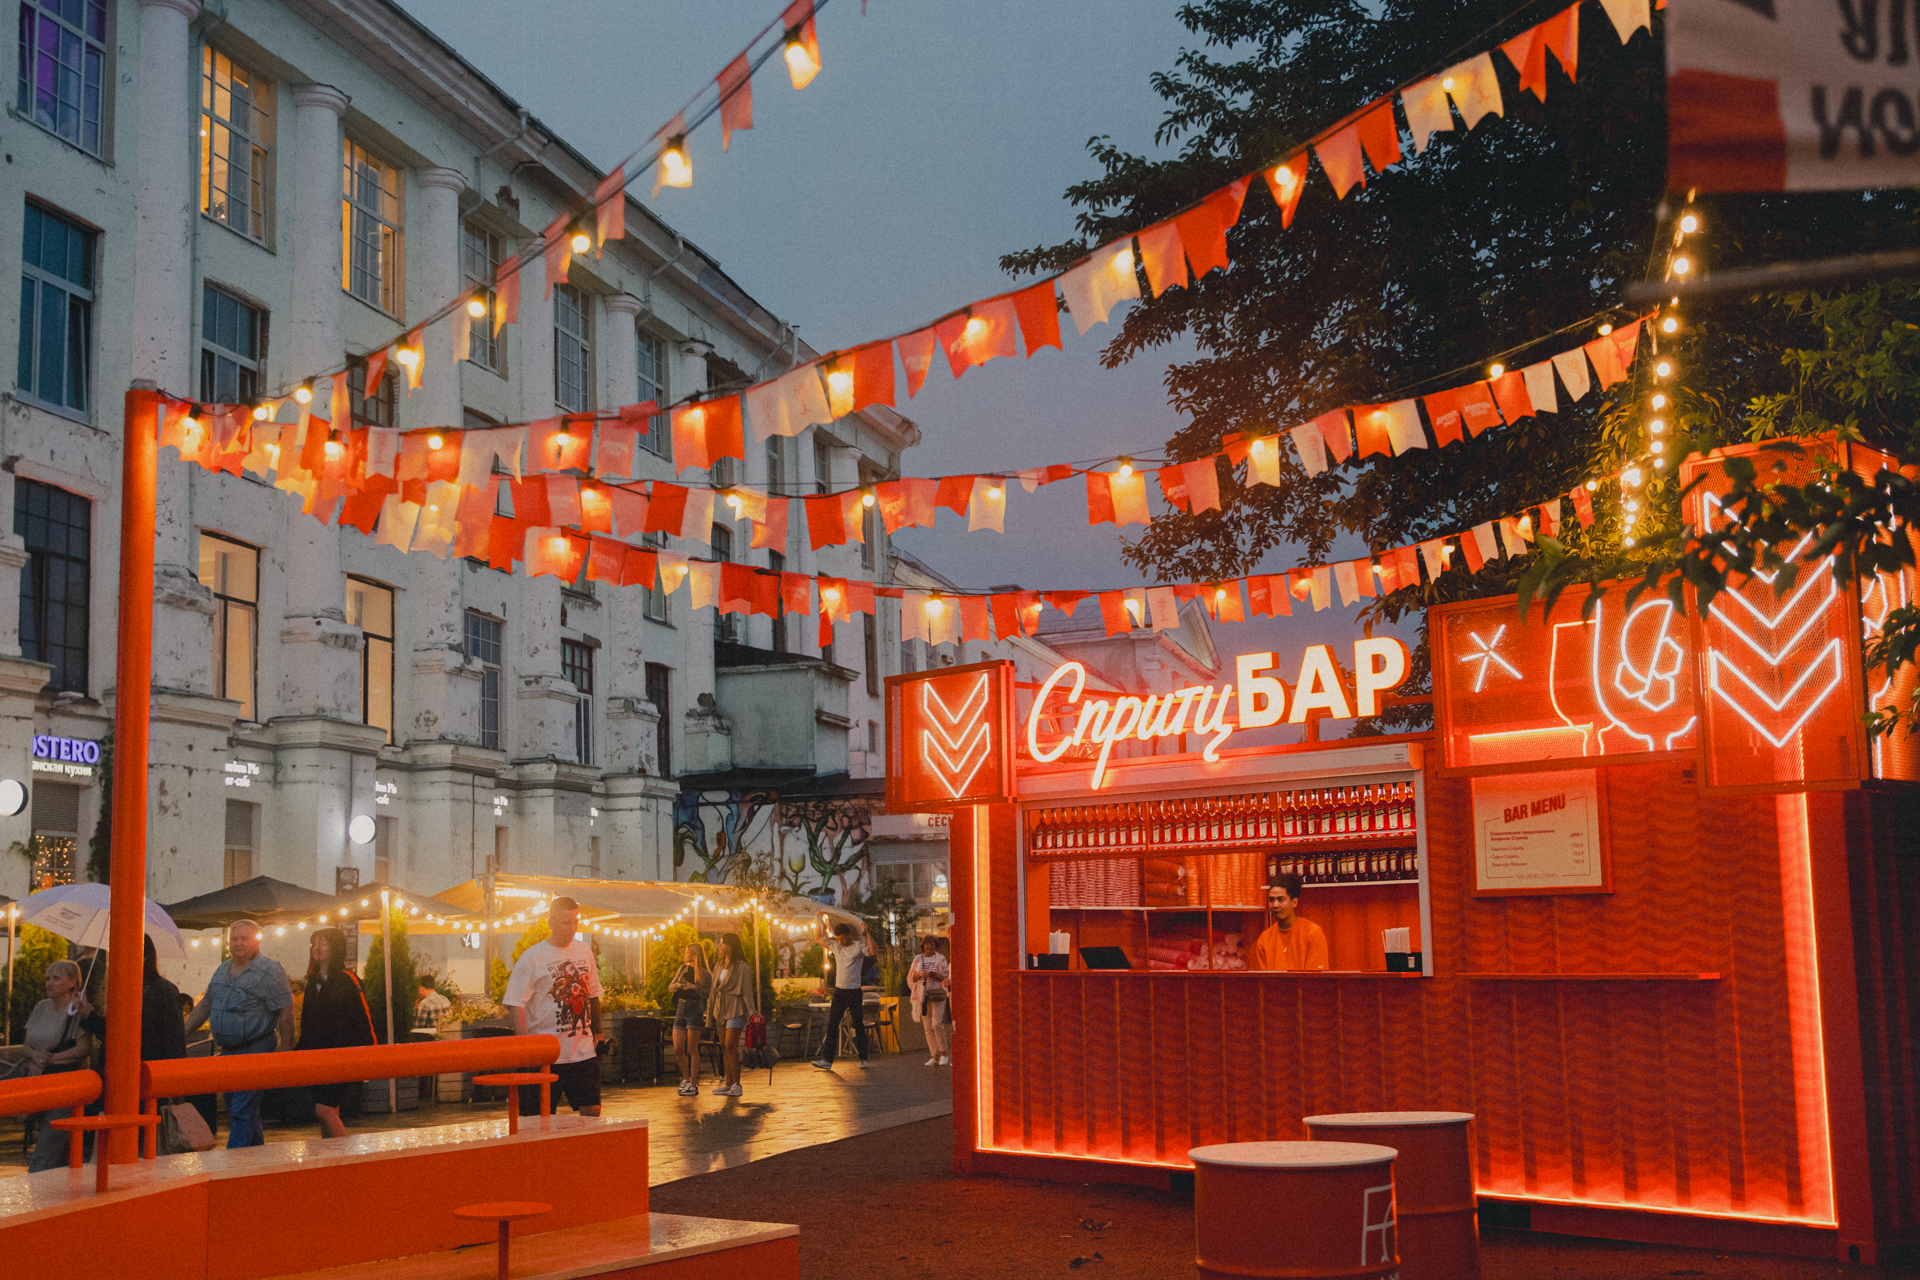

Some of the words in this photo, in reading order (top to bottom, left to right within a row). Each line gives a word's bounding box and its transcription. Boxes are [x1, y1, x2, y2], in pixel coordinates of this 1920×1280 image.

[1027, 660, 1234, 791] Спритц
[1235, 636, 1411, 729] БАР
[64, 765, 93, 778] кухня
[1503, 804, 1528, 824] BAR
[1530, 794, 1566, 817] MENU
